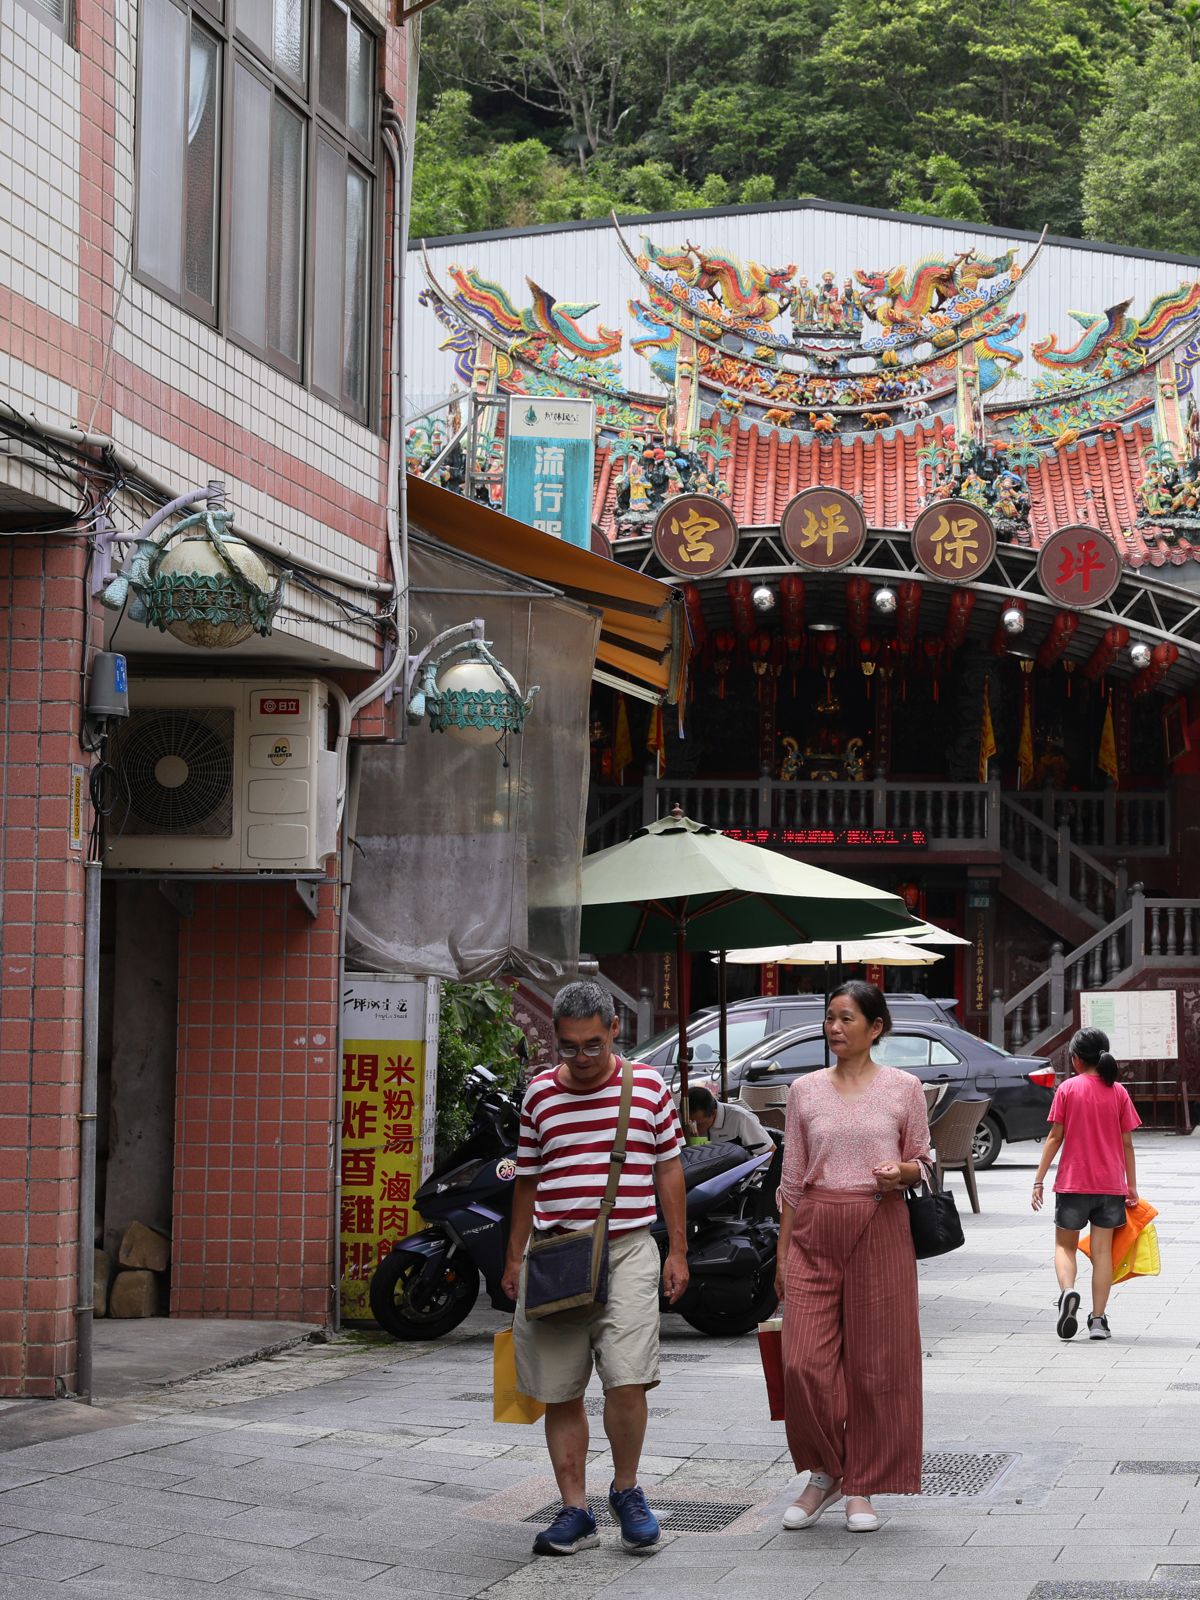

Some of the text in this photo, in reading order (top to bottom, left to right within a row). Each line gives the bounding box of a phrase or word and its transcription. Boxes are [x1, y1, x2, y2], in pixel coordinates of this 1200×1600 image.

[279, 701, 296, 711] 日立
[383, 1055, 415, 1154] 米粉湯
